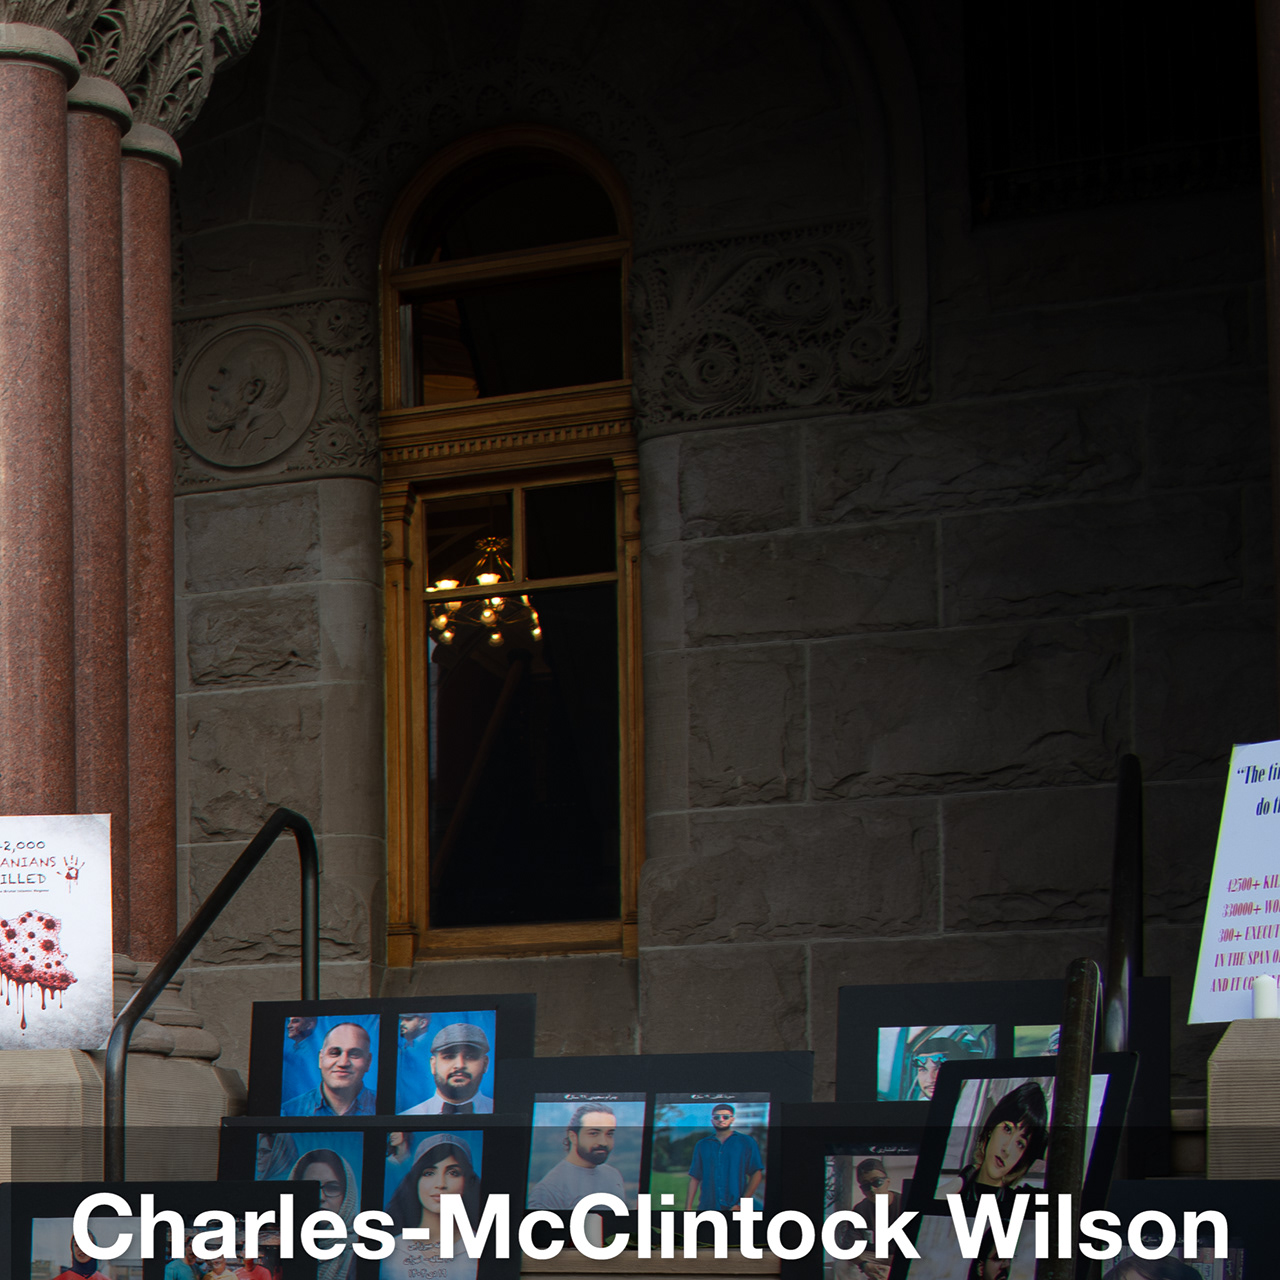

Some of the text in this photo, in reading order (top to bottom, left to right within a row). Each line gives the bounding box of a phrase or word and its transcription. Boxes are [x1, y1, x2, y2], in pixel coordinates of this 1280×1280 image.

[1256, 797, 1270, 816] do
[1265, 899, 1280, 914] WO
[1218, 928, 1242, 943] 300+
[1214, 949, 1280, 968] IN THE SPAN O
[1210, 978, 1229, 993] AND
[1230, 976, 1241, 992] IT
